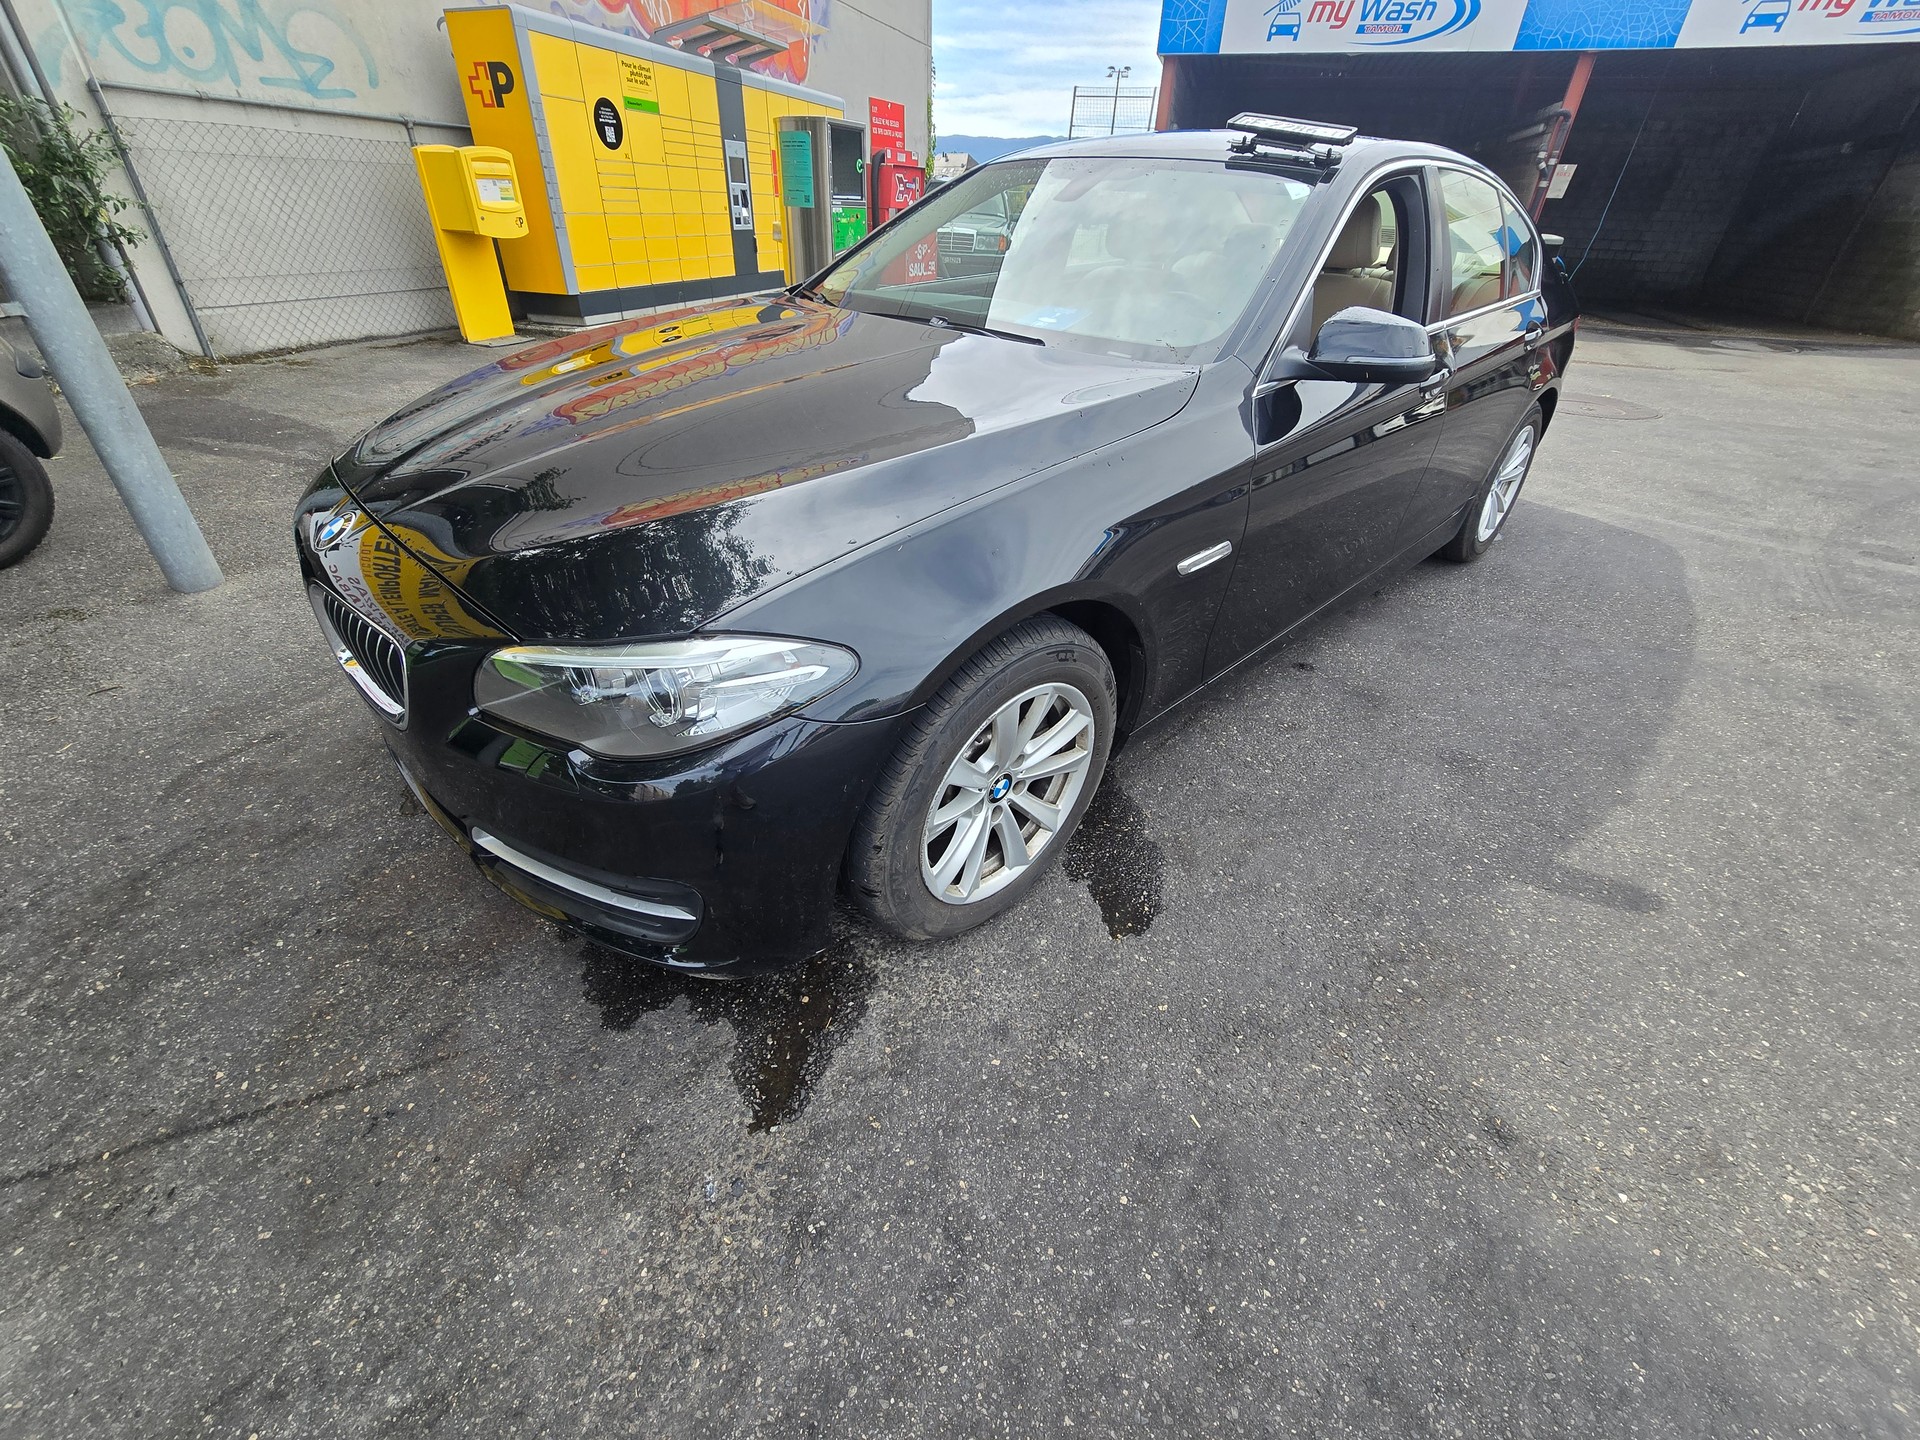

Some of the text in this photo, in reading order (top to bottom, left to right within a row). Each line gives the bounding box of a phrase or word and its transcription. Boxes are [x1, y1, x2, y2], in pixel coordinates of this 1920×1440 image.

[1306, 0, 1438, 30] my Wash
[1364, 24, 1403, 34] TAMOIL
[621, 60, 632, 68] Pour
